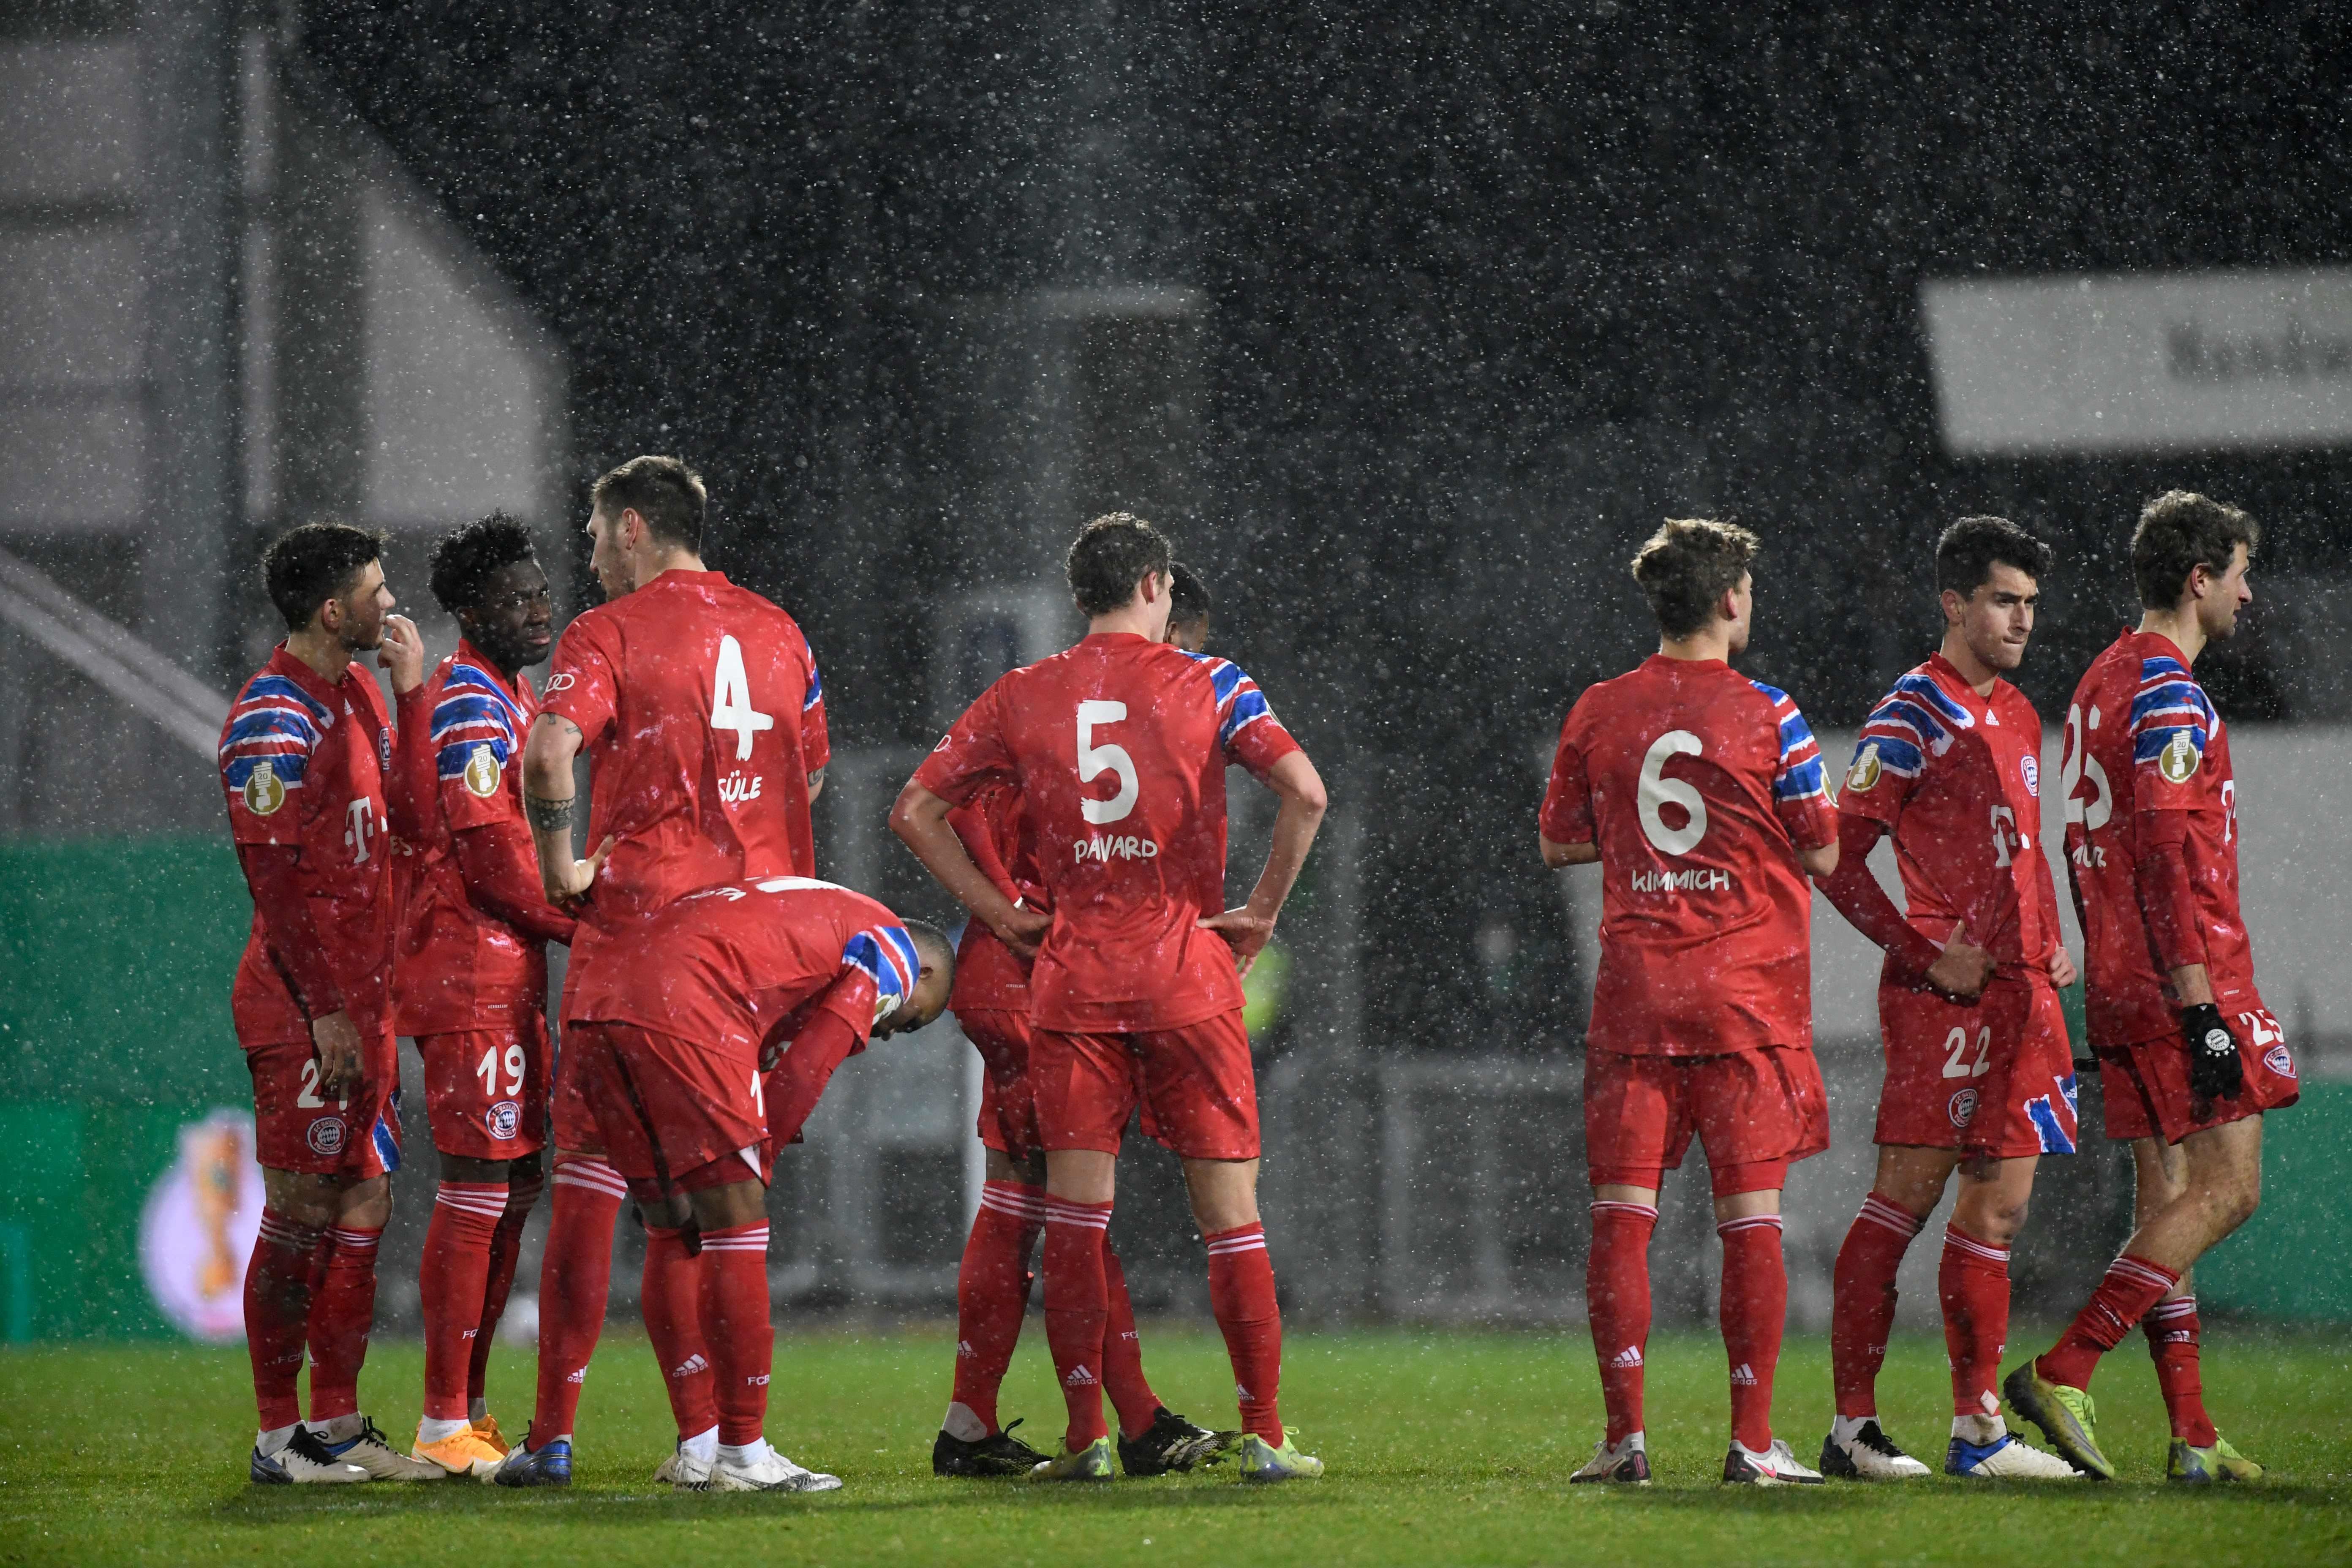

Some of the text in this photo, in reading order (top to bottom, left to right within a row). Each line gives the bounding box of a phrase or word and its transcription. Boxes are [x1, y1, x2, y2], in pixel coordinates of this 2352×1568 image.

[710, 634, 773, 761] 4
[1077, 700, 1139, 824] 5
[1638, 730, 1707, 856] 6
[1073, 834, 1158, 864] PAVARD
[1632, 869, 1730, 892] KIMMICH
[2239, 1009, 2284, 1046] 25
[1942, 1026, 1990, 1078] 22
[477, 1044, 526, 1096] 19
[498, 1104, 517, 1113] BAYERN
[462, 1328, 479, 1339] FC
[672, 1362, 708, 1377] adidas
[1610, 1359, 1643, 1368] adidas
[747, 1374, 770, 1386] FCB
[1067, 1377, 1098, 1386] adidas
